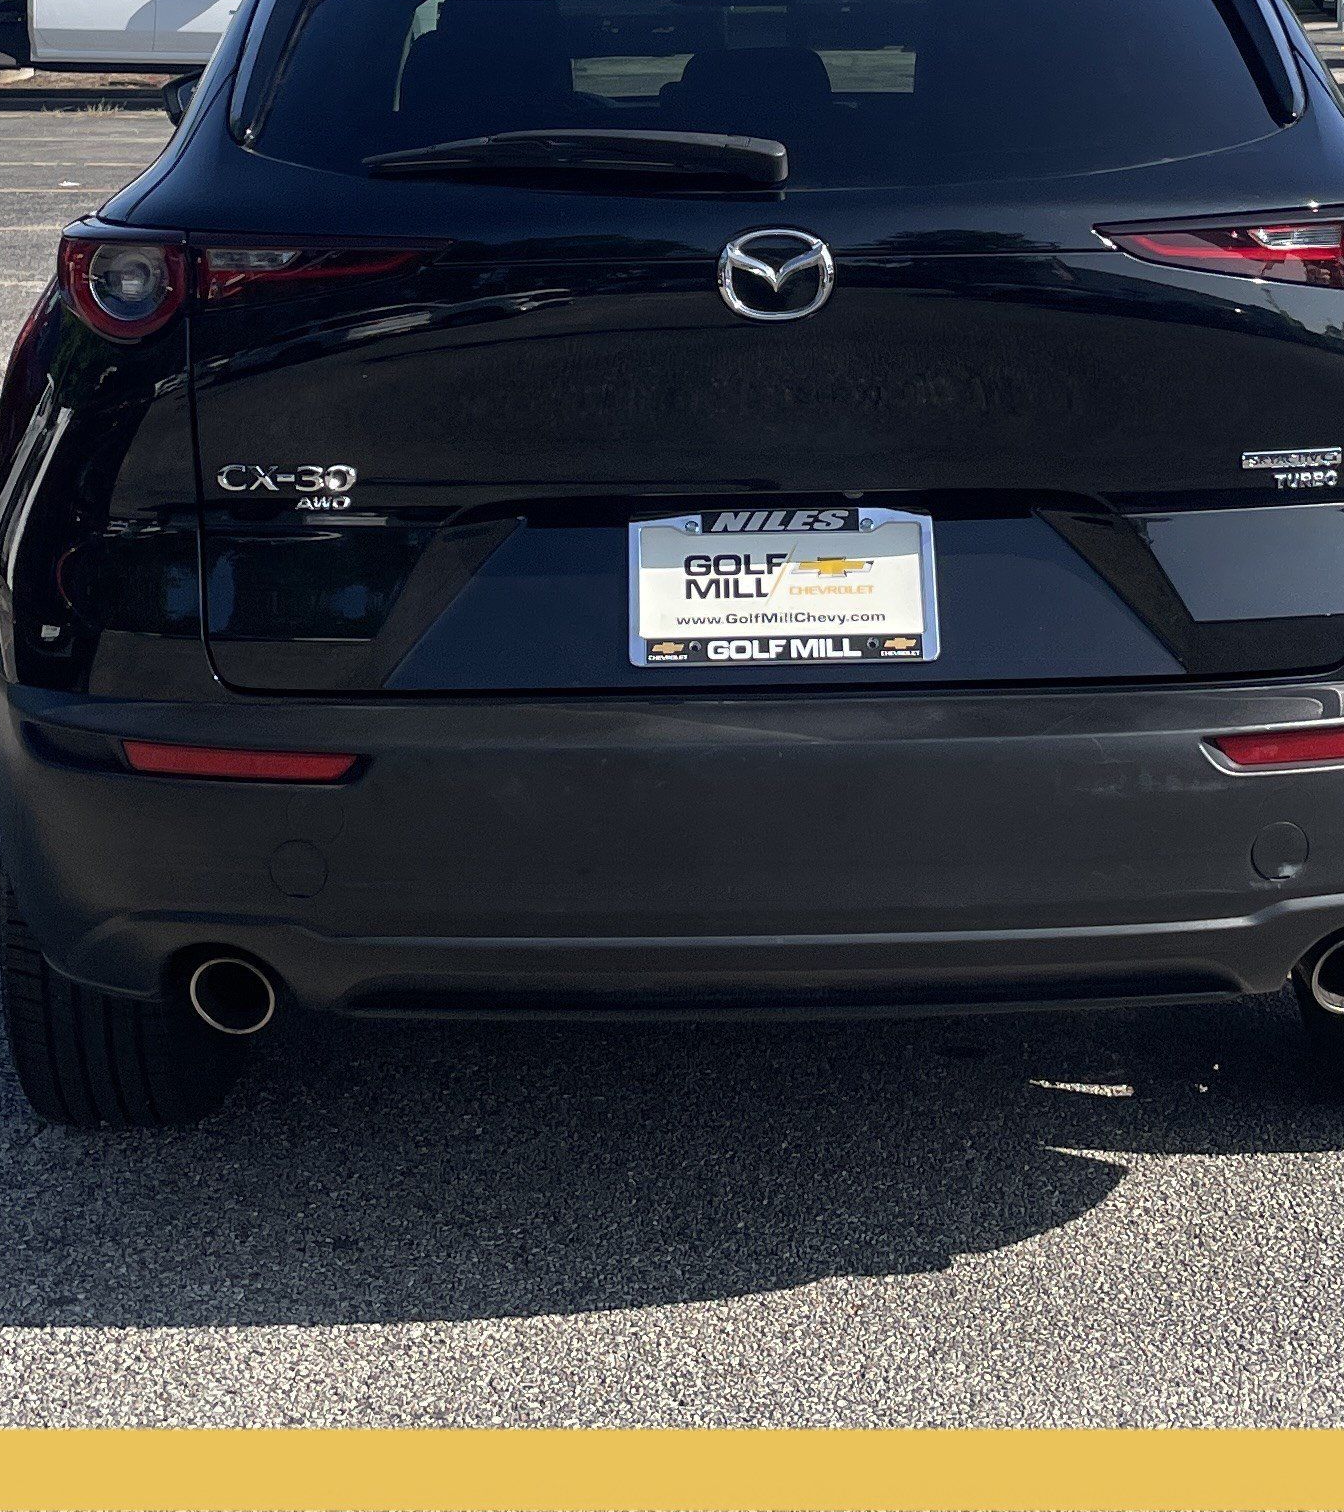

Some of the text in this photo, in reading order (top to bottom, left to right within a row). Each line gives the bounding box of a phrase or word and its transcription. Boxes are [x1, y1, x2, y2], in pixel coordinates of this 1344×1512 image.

[217, 464, 357, 491] CX-30
[1274, 470, 1339, 489] TURBO
[710, 509, 851, 532] NILES
[684, 553, 788, 577] GOLF
[685, 578, 770, 600] MILL
[789, 584, 875, 596] CHEVROLET
[676, 612, 887, 626] www.GolfMillChevy.com
[707, 638, 863, 660] GOLF MILL
